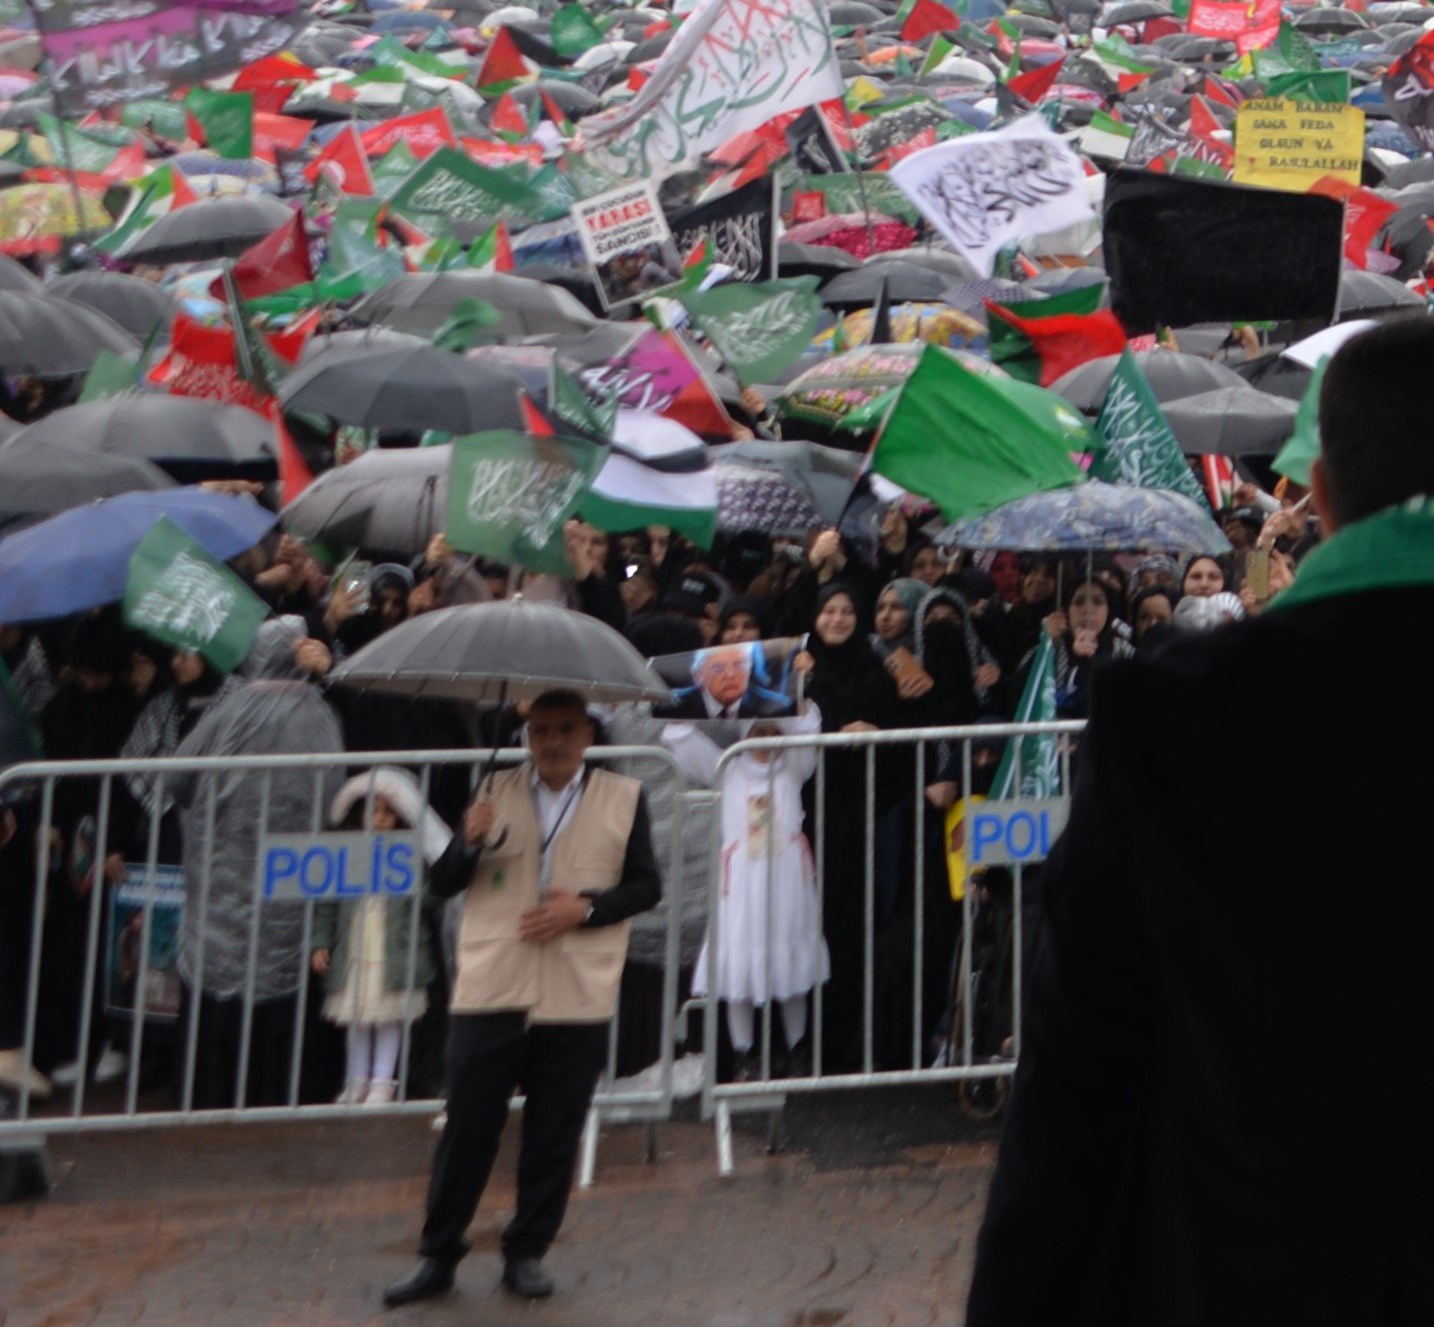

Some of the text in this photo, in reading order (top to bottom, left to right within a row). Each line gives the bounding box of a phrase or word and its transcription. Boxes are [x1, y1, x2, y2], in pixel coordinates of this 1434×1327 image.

[1253, 119, 1334, 130] SANA FEDA
[1259, 138, 1334, 150] OLSUN YA
[263, 835, 413, 900] POLİS
